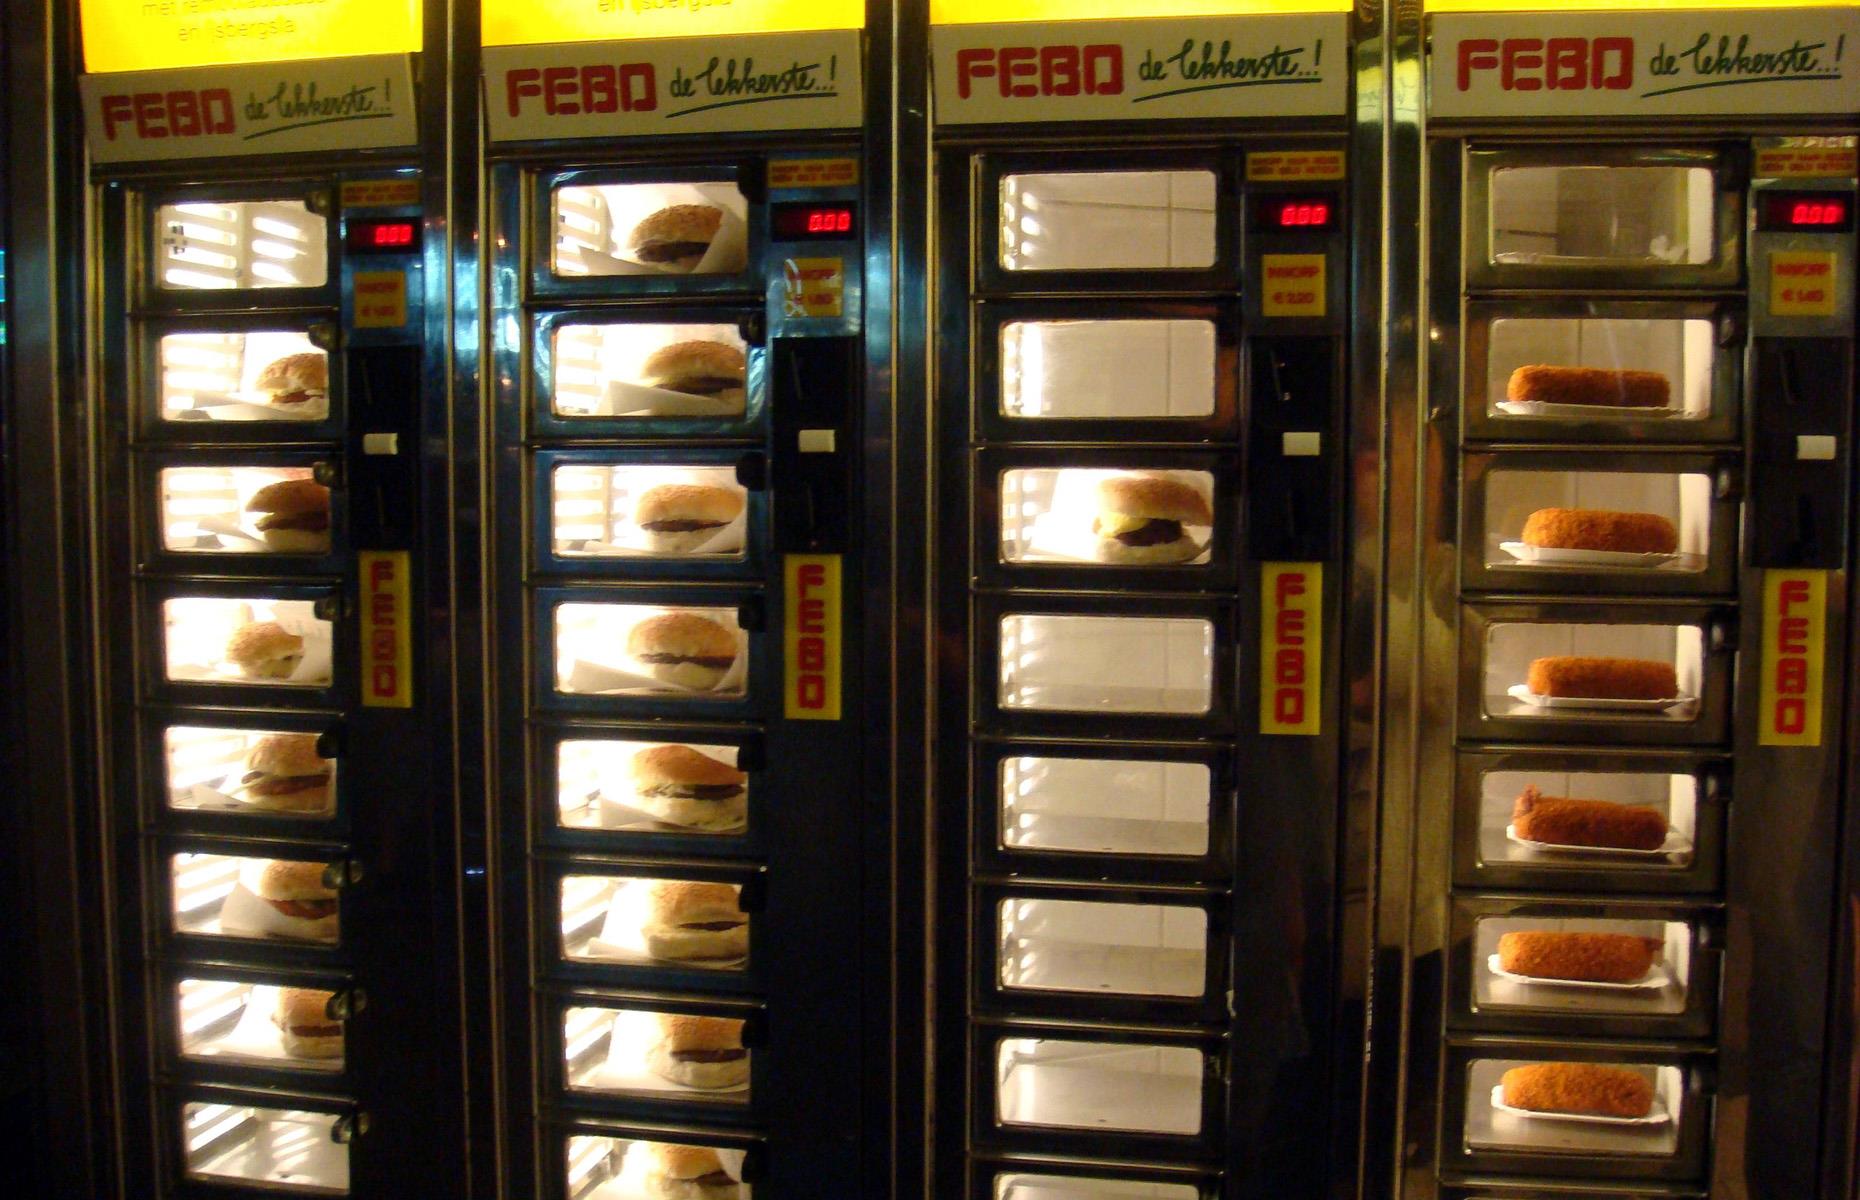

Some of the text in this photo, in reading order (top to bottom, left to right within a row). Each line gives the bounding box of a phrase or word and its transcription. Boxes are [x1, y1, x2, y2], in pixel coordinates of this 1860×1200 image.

[506, 62, 658, 118] FEBO
[669, 66, 697, 98] de
[957, 43, 1124, 99] FEBO
[1138, 49, 1168, 81] de
[1456, 36, 1635, 92] FEBO
[1649, 42, 1681, 77] de
[101, 87, 236, 142] FEBO
[244, 92, 270, 121] de
[370, 559, 397, 698] FEBO
[797, 563, 826, 710] FEBO
[1274, 572, 1307, 725] FEBO
[1774, 579, 1810, 735] FEBO
